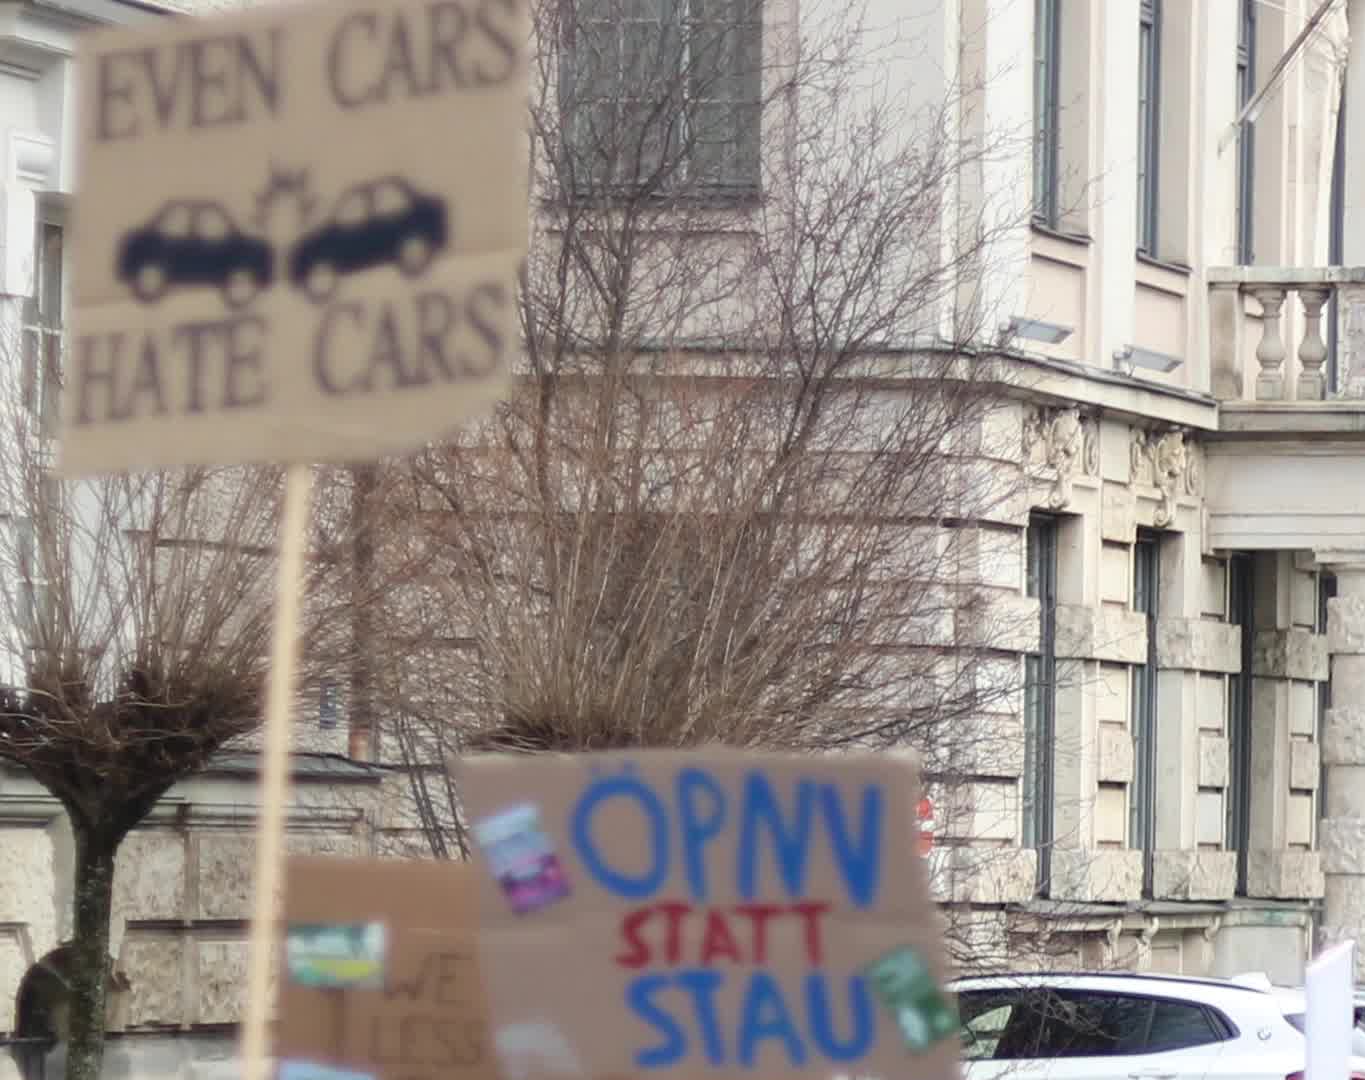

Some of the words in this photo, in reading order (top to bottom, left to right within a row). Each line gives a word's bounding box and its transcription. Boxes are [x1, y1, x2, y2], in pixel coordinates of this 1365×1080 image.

[95, 33, 283, 142] EVEN
[327, 0, 518, 109] CARS
[71, 313, 265, 427] HATE
[312, 286, 508, 398] CARS
[569, 760, 883, 909] ÖPNV
[615, 902, 836, 969] STATT
[625, 969, 876, 1070] STAU
